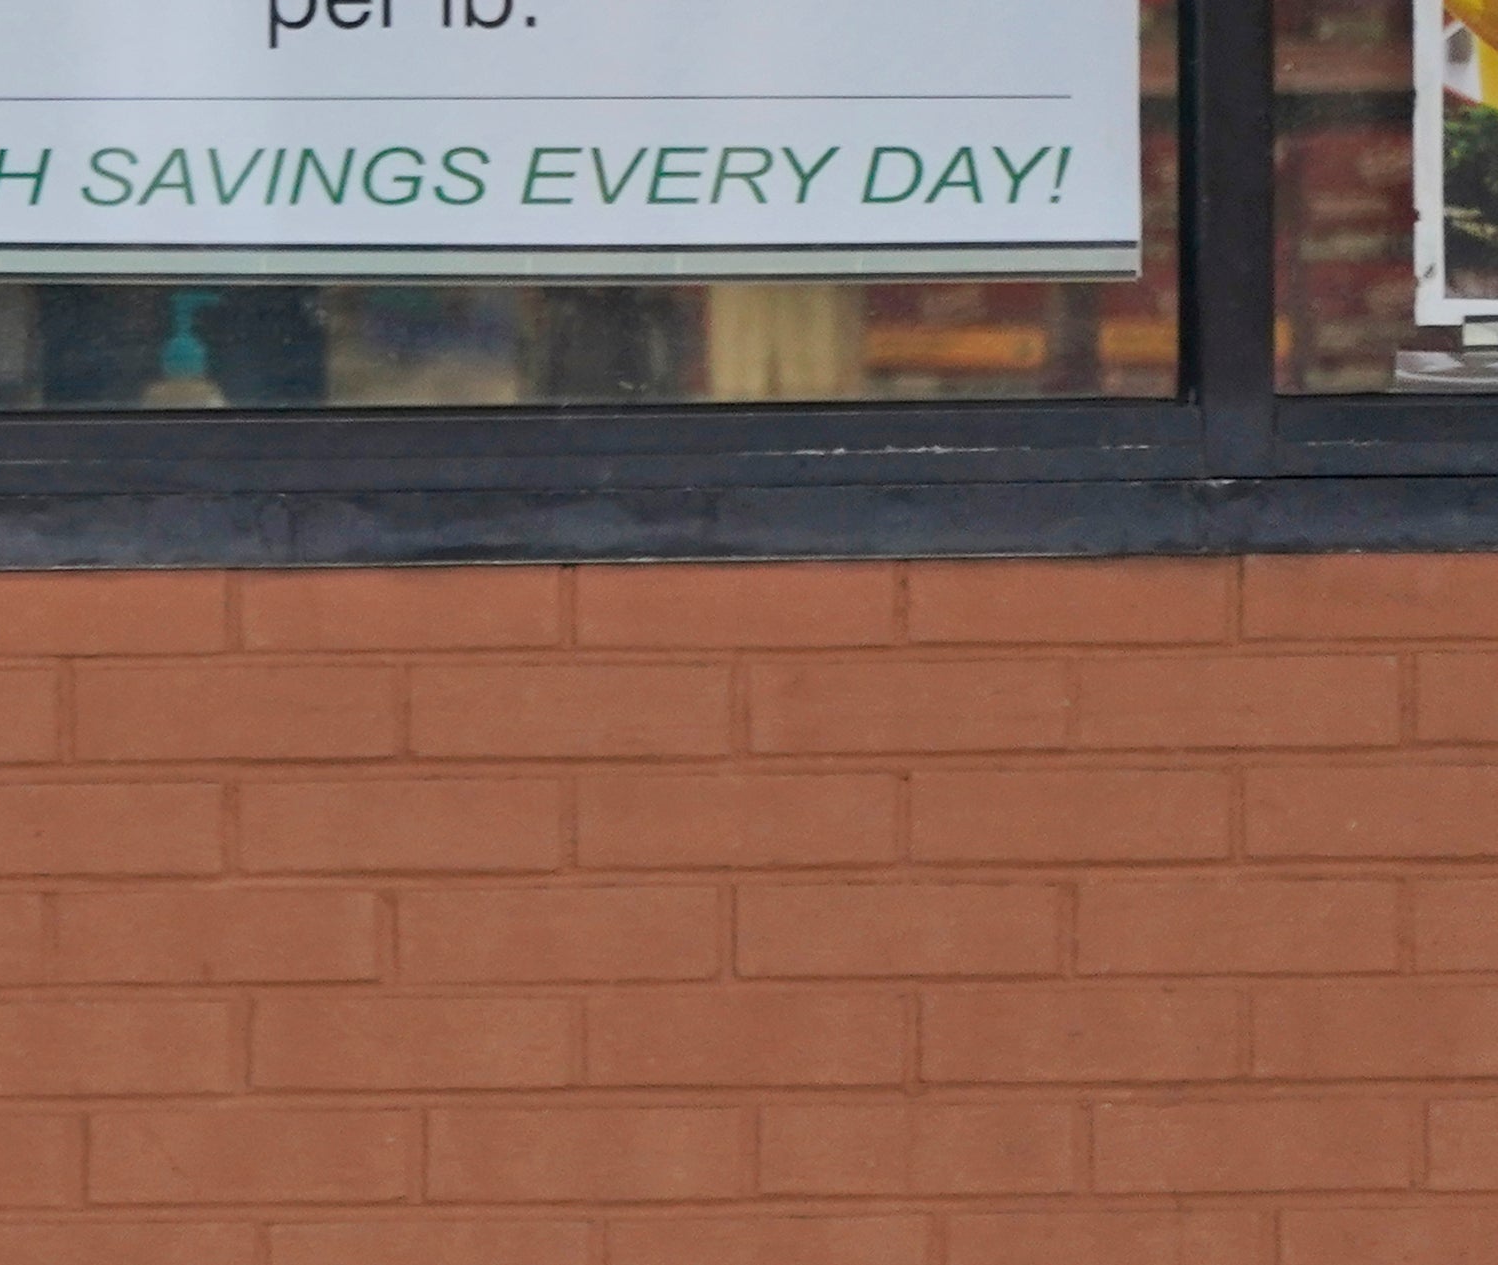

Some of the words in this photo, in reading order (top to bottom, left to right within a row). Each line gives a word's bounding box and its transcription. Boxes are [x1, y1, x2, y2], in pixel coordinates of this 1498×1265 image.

[81, 145, 491, 210] SAVINGS
[521, 146, 841, 208] EVERY
[863, 146, 1076, 206] DAY!
